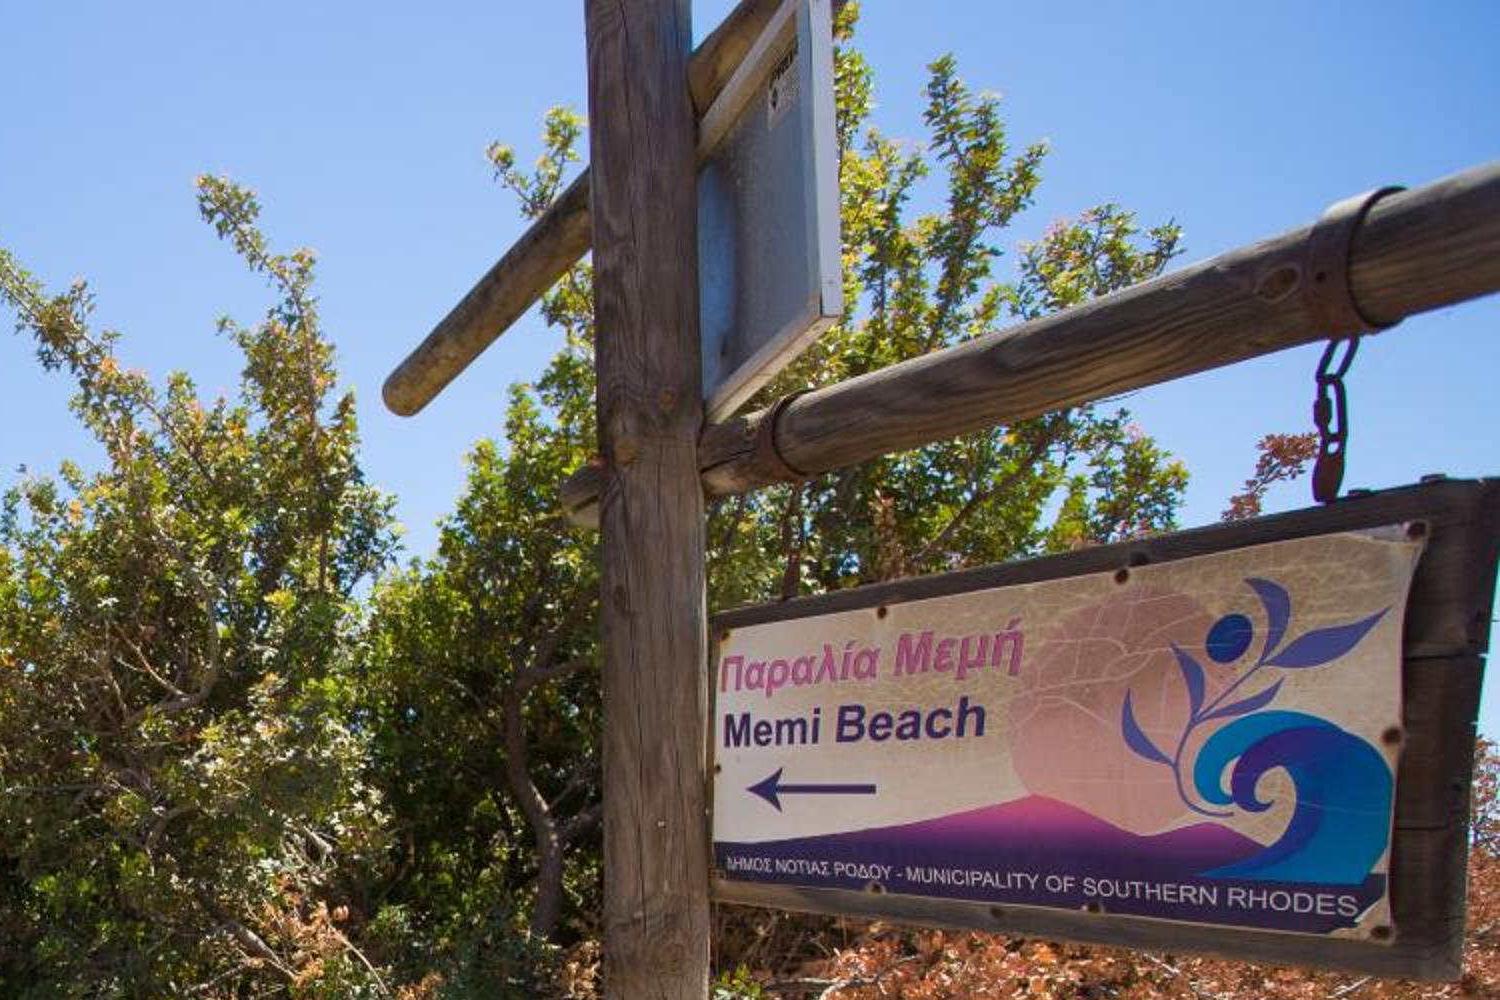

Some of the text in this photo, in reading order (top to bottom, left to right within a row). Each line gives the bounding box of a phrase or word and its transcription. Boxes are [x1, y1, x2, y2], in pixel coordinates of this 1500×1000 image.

[720, 617, 1025, 696] Παραλία Μεμή
[723, 696, 986, 748] Memi Beach
[776, 857, 832, 877] ΝΟΤΙΑΣ
[834, 861, 892, 881] ΡΟΔΟΥ
[906, 867, 1039, 891] MUNICIPALITY
[1045, 875, 1076, 893] OF
[1082, 877, 1218, 906] SOUTHERN
[1227, 886, 1359, 918] RHODES
